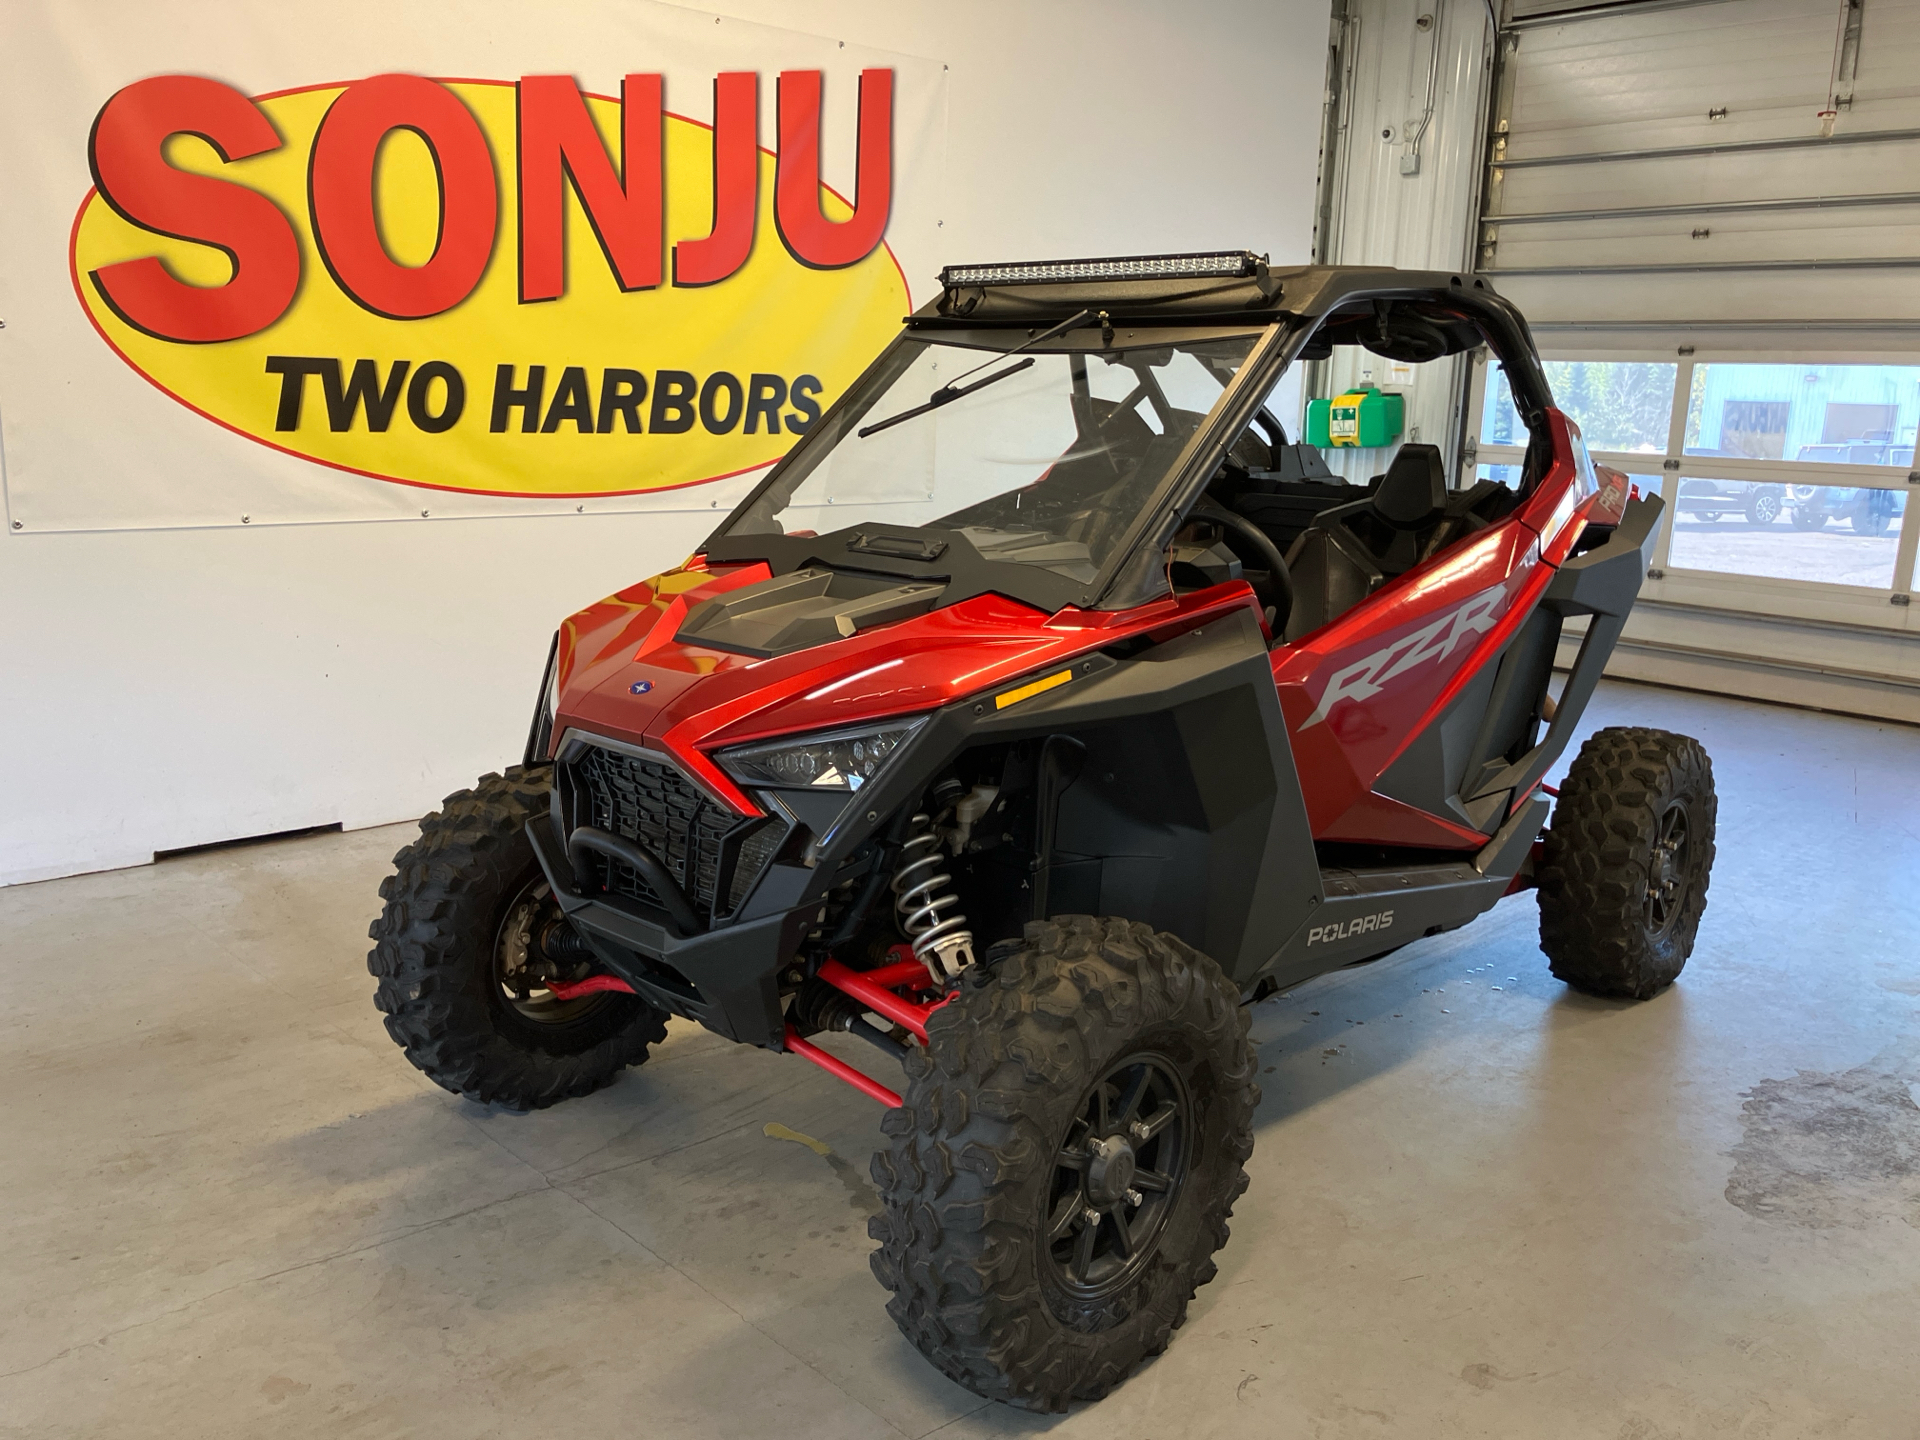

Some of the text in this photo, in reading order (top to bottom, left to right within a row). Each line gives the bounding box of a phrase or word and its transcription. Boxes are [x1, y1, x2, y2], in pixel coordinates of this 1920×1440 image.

[88, 68, 893, 344] SONJU
[265, 356, 823, 436] TWO HARBORS
[1598, 485, 1620, 512] PRO
[1296, 583, 1507, 733] RZR
[1307, 910, 1394, 947] POLARIS
